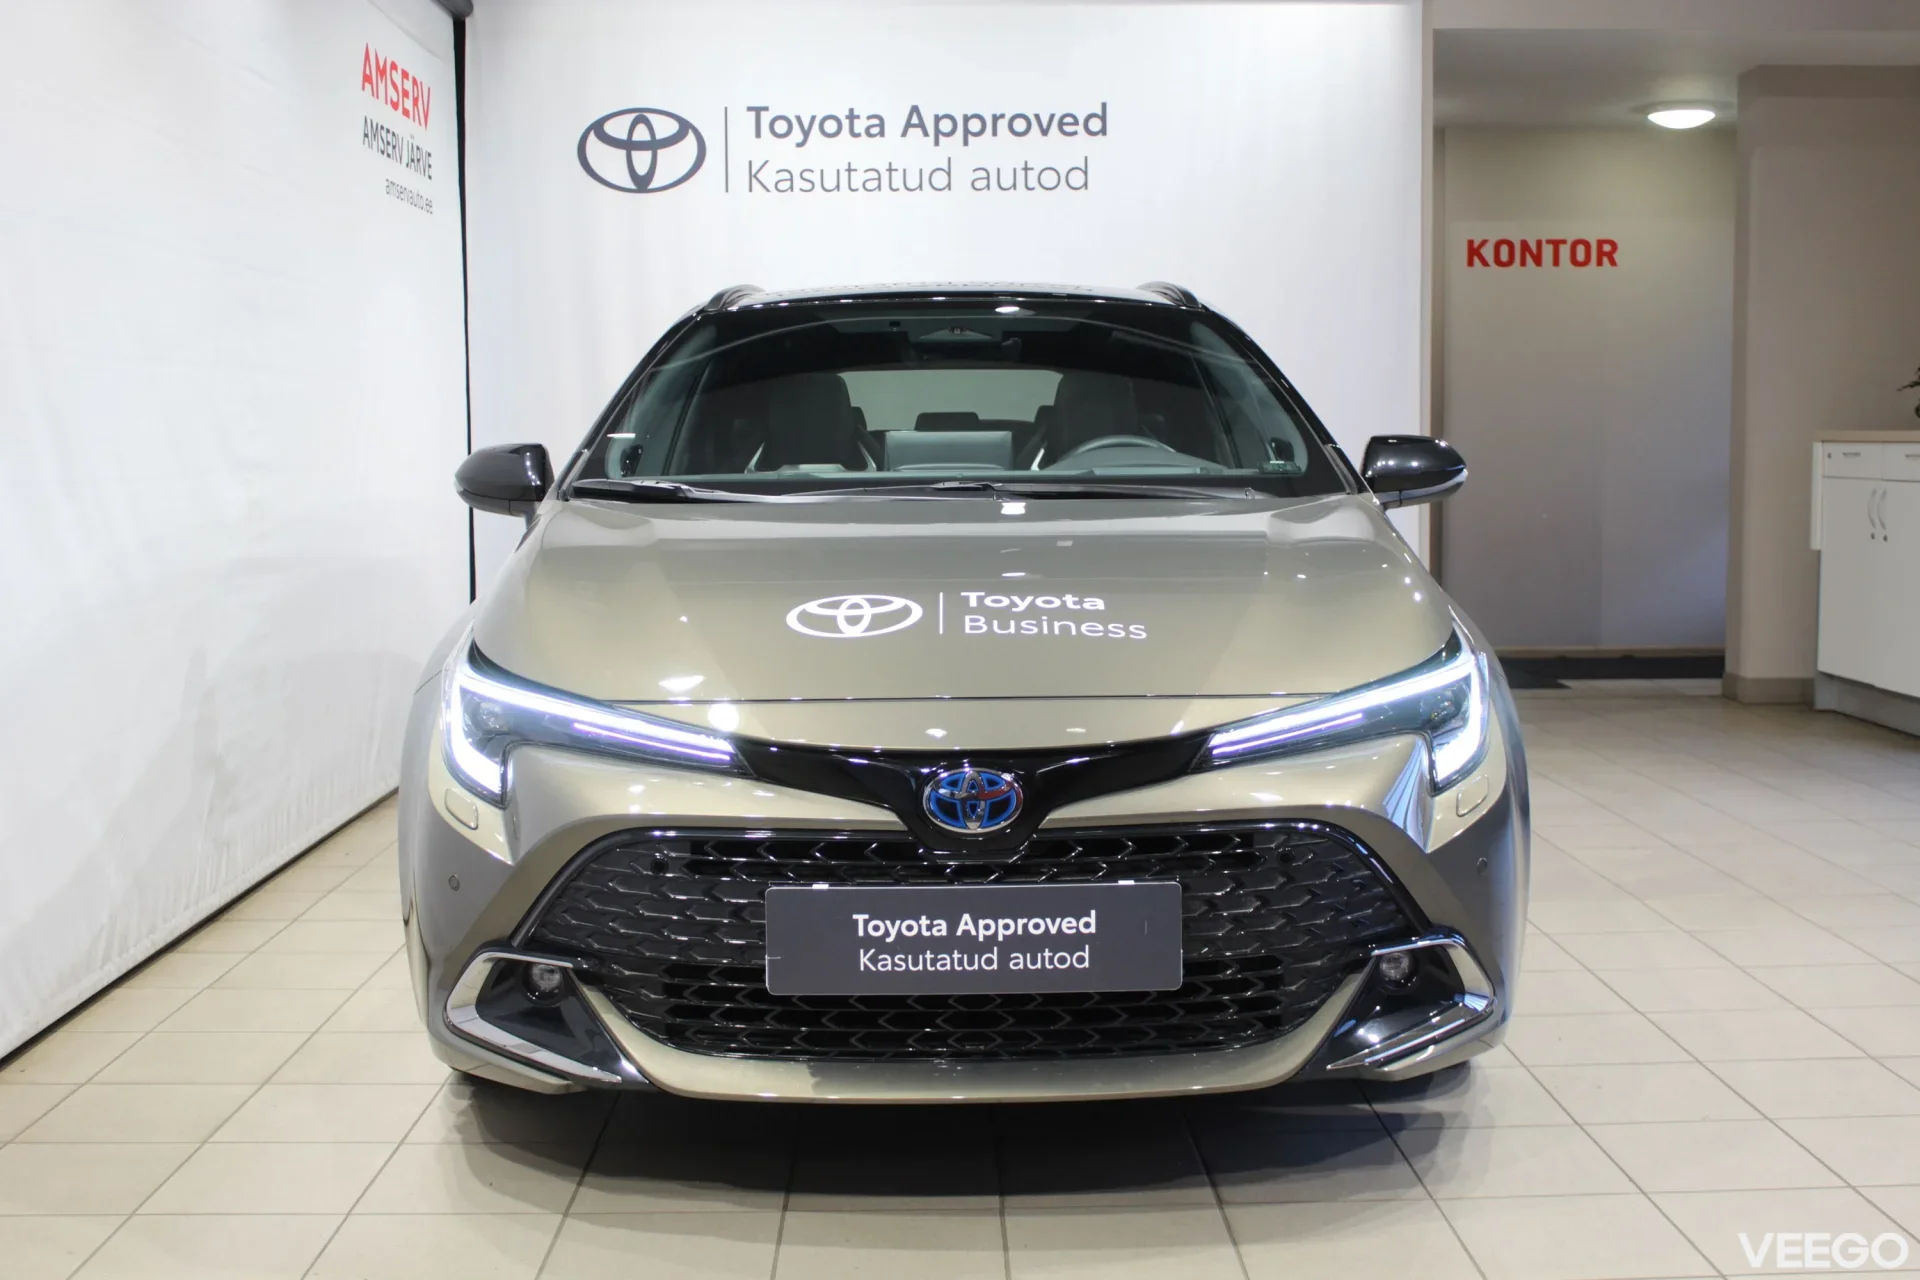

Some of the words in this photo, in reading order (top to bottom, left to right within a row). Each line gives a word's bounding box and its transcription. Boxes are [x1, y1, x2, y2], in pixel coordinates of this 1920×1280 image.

[361, 42, 431, 131] AMSERV
[746, 106, 887, 148] Toyota
[900, 102, 1109, 147] Approved
[362, 115, 404, 165] AMSERV
[405, 134, 433, 180] JÄRVE
[747, 157, 952, 193] Kasutatud
[971, 156, 1090, 192] autod
[385, 178, 433, 215] amservauto.ee
[1466, 238, 1619, 268] KONTOR
[960, 591, 1106, 612] Toyota
[963, 615, 1148, 639] Business
[852, 913, 947, 943] Toyota
[956, 910, 1097, 941] Approved
[859, 946, 998, 972] Kasutatud
[1009, 945, 1090, 970] autod
